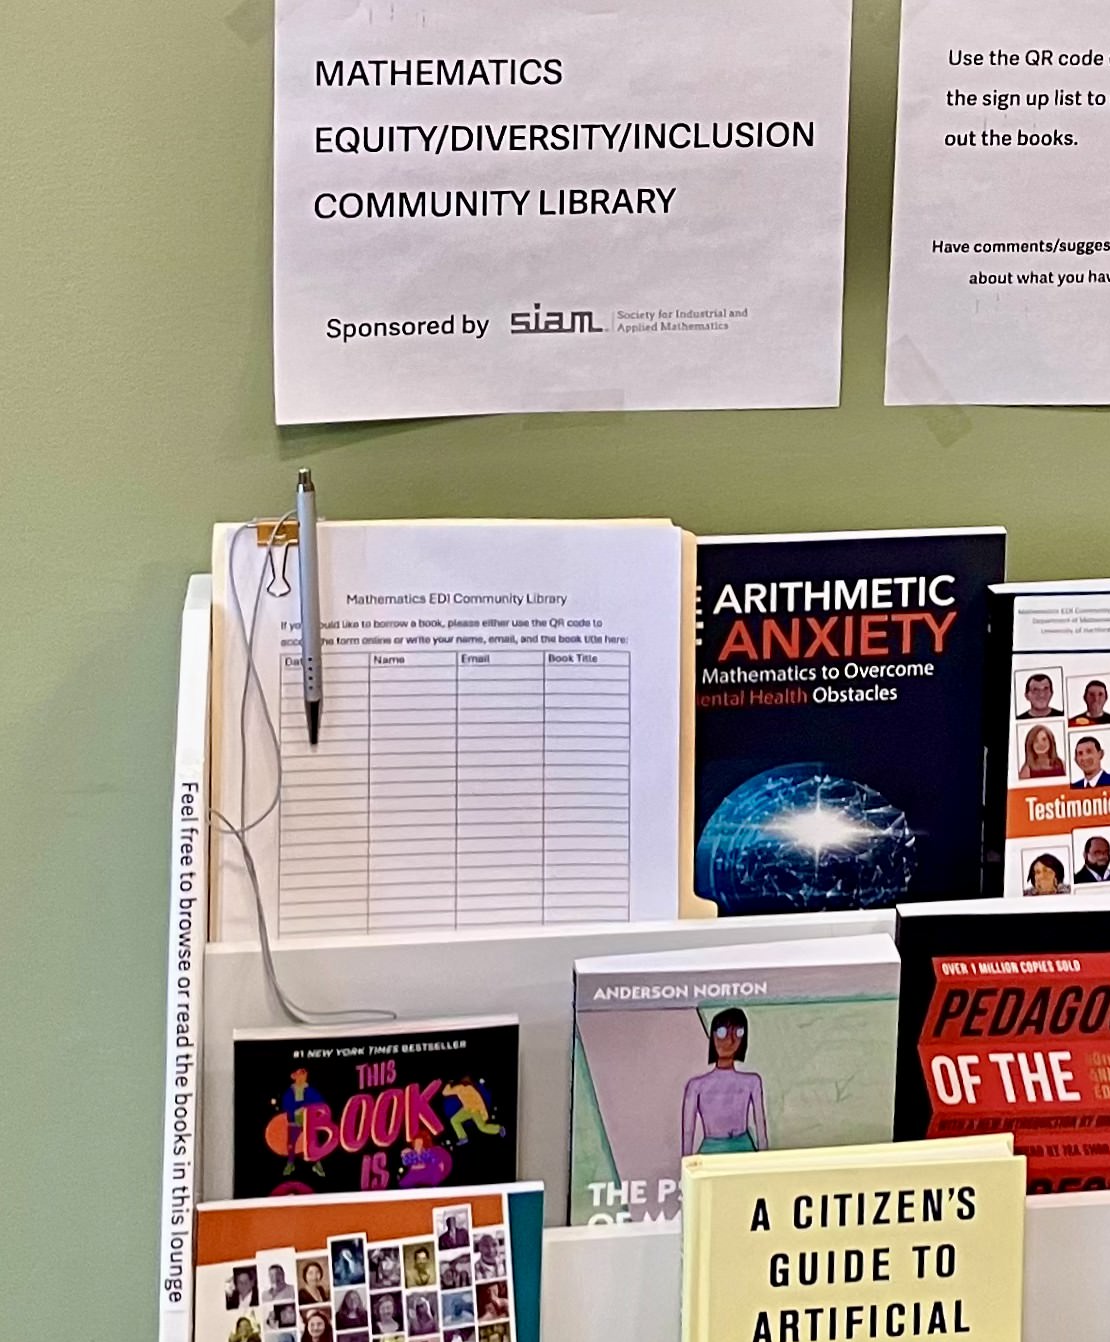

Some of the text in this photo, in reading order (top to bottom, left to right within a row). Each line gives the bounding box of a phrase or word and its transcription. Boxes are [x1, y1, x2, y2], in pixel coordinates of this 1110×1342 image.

[315, 57, 562, 87] MATHEMATICS
[947, 48, 984, 66] Use
[988, 48, 1020, 66] the
[1024, 48, 1053, 67] QR
[1057, 48, 1104, 66] code
[945, 88, 978, 106] the
[981, 88, 1020, 111] sign
[1025, 92, 1050, 111] up
[1053, 88, 1082, 106] list
[1086, 89, 1106, 106] to
[315, 120, 814, 155] EQUITY/DIVERSITY/INCLUSION
[943, 128, 1078, 147] out the books.
[313, 186, 677, 219] COMMUNITY LIBRARY
[931, 238, 970, 254] Have
[968, 270, 1013, 285] about
[1015, 270, 1054, 284] what
[1056, 272, 1085, 287] you
[325, 313, 490, 343] Sponsored by
[511, 303, 604, 334] siam
[616, 306, 748, 322] Society for Industrial and
[617, 320, 730, 334] Applied Mathematics
[345, 593, 426, 605] Mathematics
[452, 591, 524, 607] Community
[525, 592, 568, 607] Library
[712, 574, 955, 614] ARITHMETIC
[717, 612, 957, 661] ANXIETY
[701, 661, 935, 684] Mathematics to Overcome
[811, 683, 898, 704] Obstacles
[592, 978, 767, 1000] ANDERSON NORTON
[163, 781, 199, 1303] Feel free to browse or read the books in this lounge
[356, 1060, 396, 1089] THIS
[931, 1051, 1082, 1105] OF THE
[303, 1079, 444, 1161] BOOK
[749, 1186, 975, 1232] A CITIZEN'S
[768, 1243, 955, 1288] GUIDE TO
